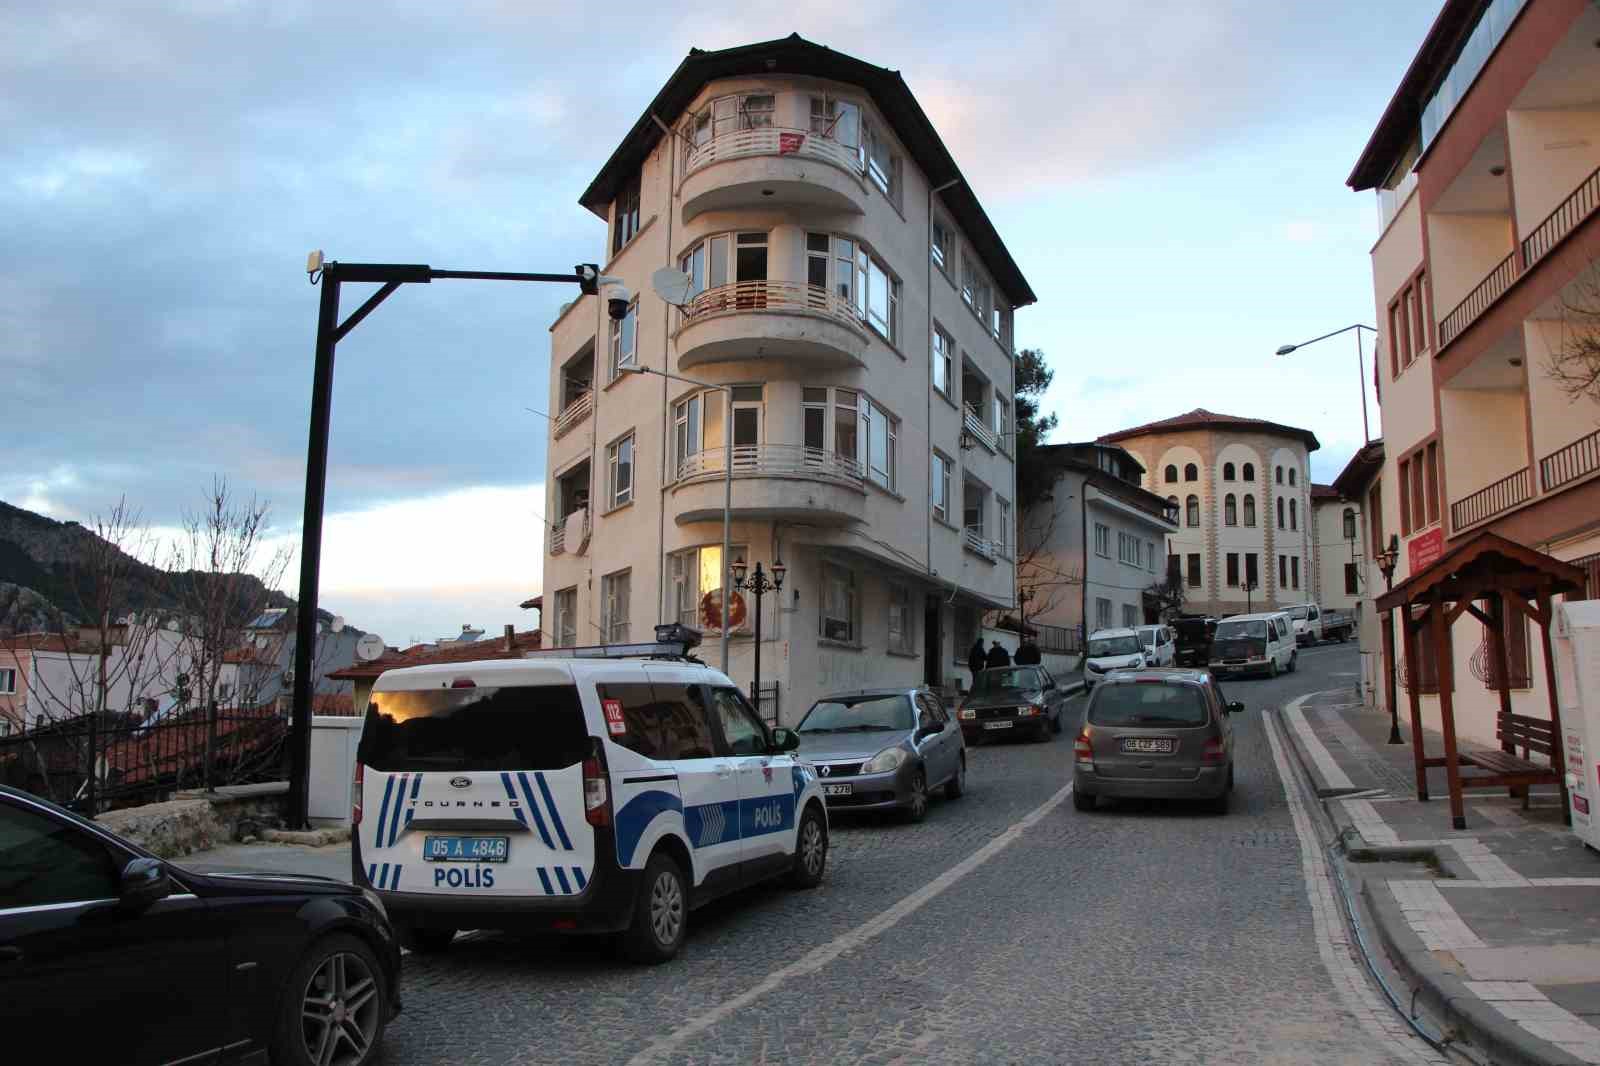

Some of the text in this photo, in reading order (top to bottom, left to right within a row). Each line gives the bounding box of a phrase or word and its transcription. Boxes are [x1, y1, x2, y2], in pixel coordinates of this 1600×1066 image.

[606, 703, 622, 720] 112
[411, 800, 520, 808] TOURNEO
[754, 800, 782, 829] POLİS
[432, 839, 448, 855] 05
[454, 840, 463, 855] A
[434, 864, 494, 888] POLİS
